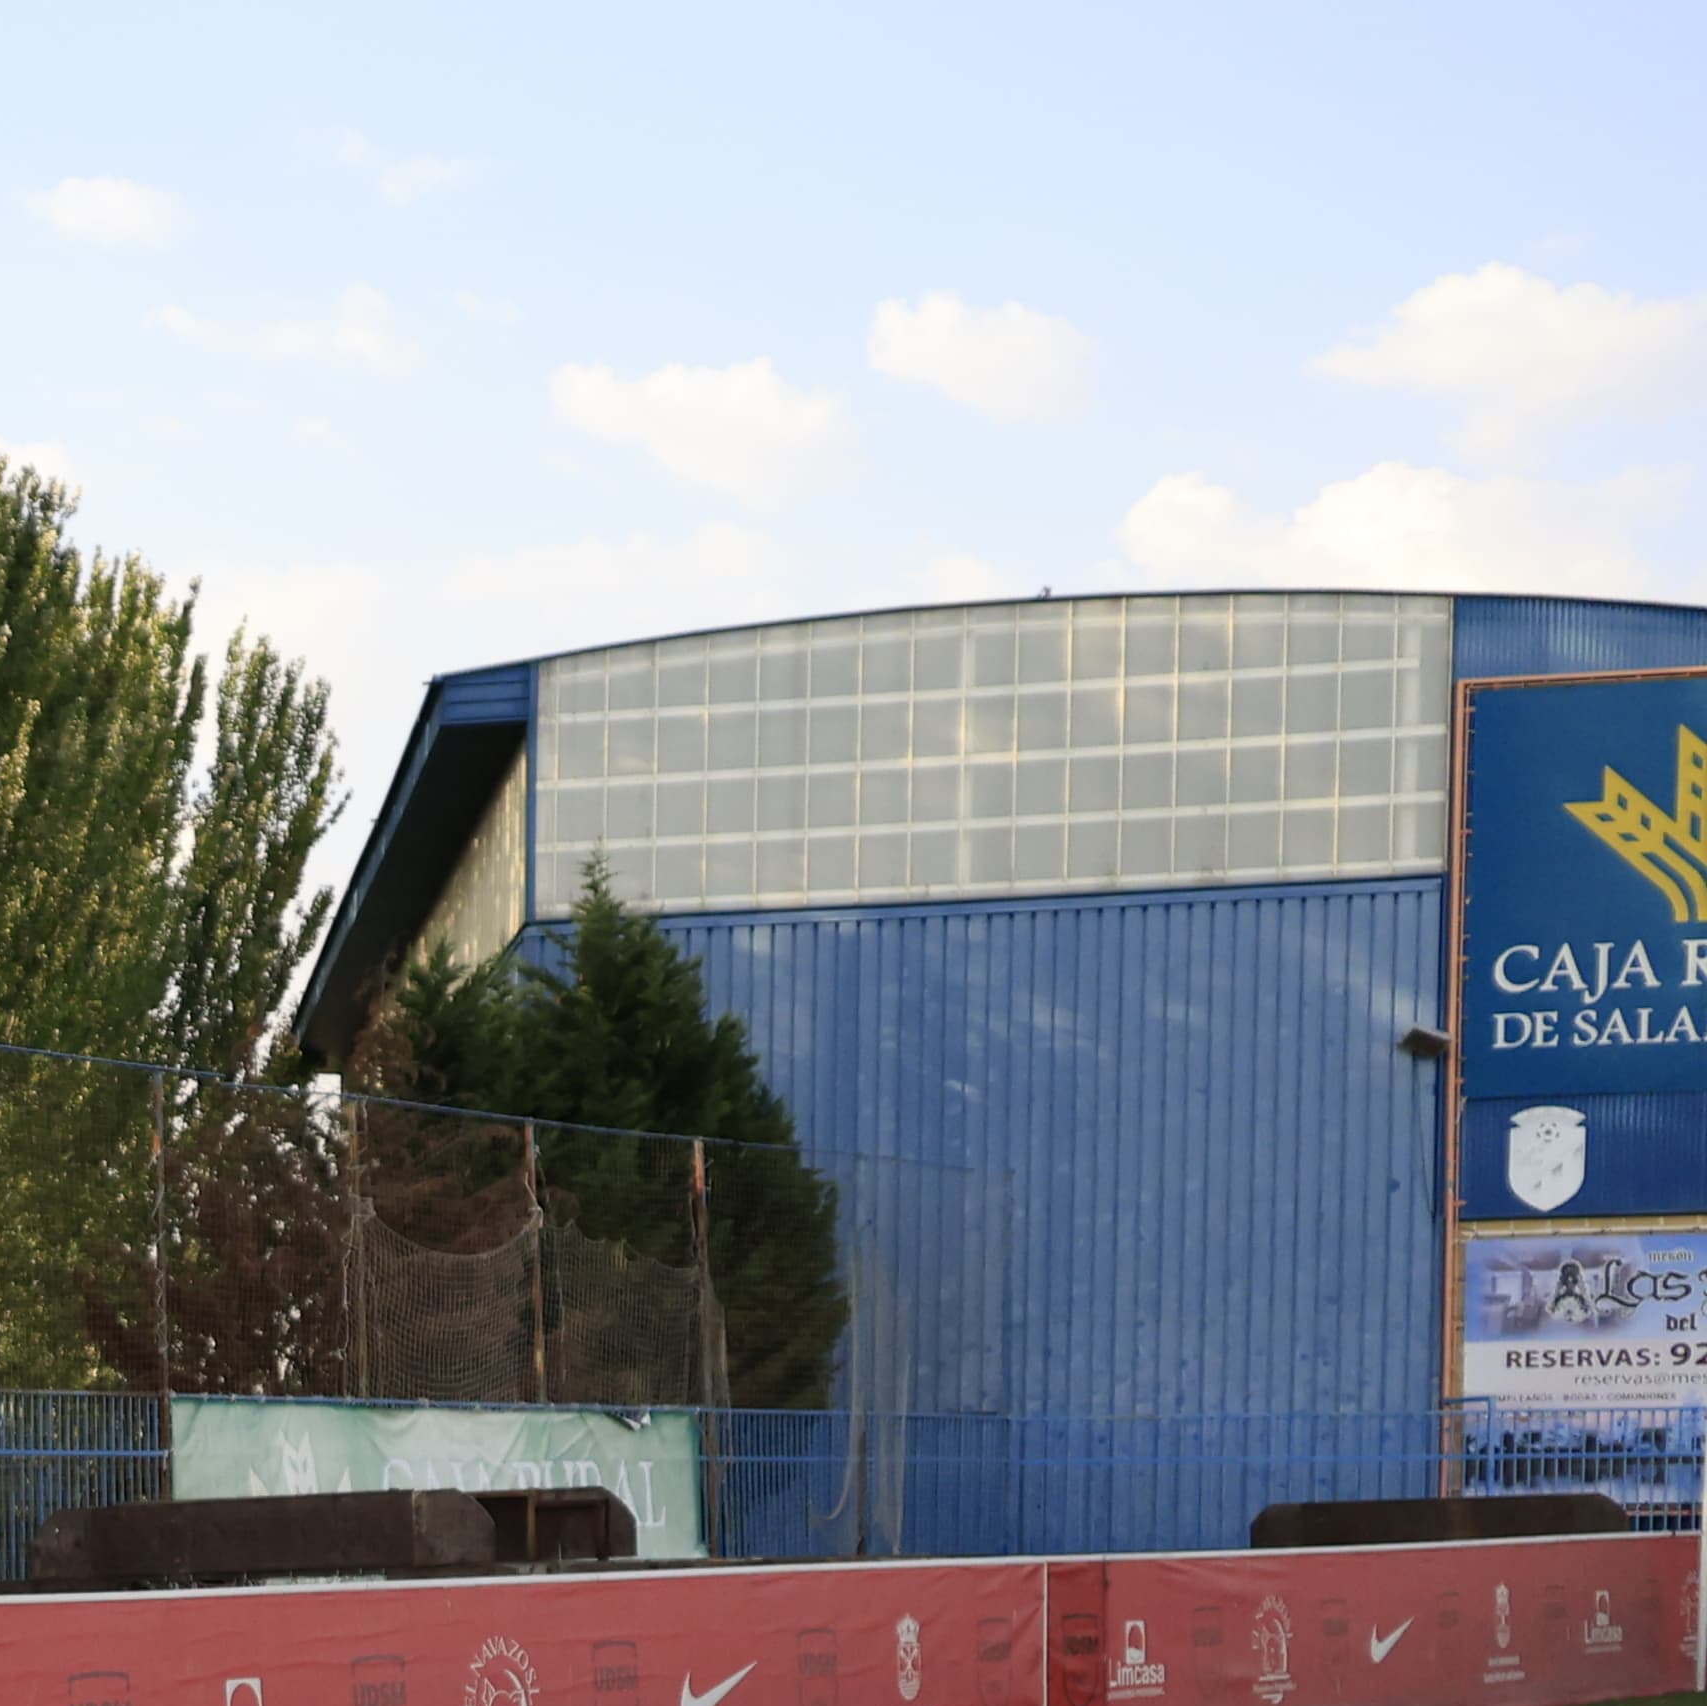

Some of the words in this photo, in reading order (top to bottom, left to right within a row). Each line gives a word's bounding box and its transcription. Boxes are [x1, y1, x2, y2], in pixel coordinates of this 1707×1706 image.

[1493, 939, 1662, 1003] CAJA
[1493, 1010, 1558, 1049] DE
[1573, 1005, 1707, 1047] SALA
[1666, 1313, 1697, 1332] del
[1506, 1348, 1660, 1368] RESERVAS:
